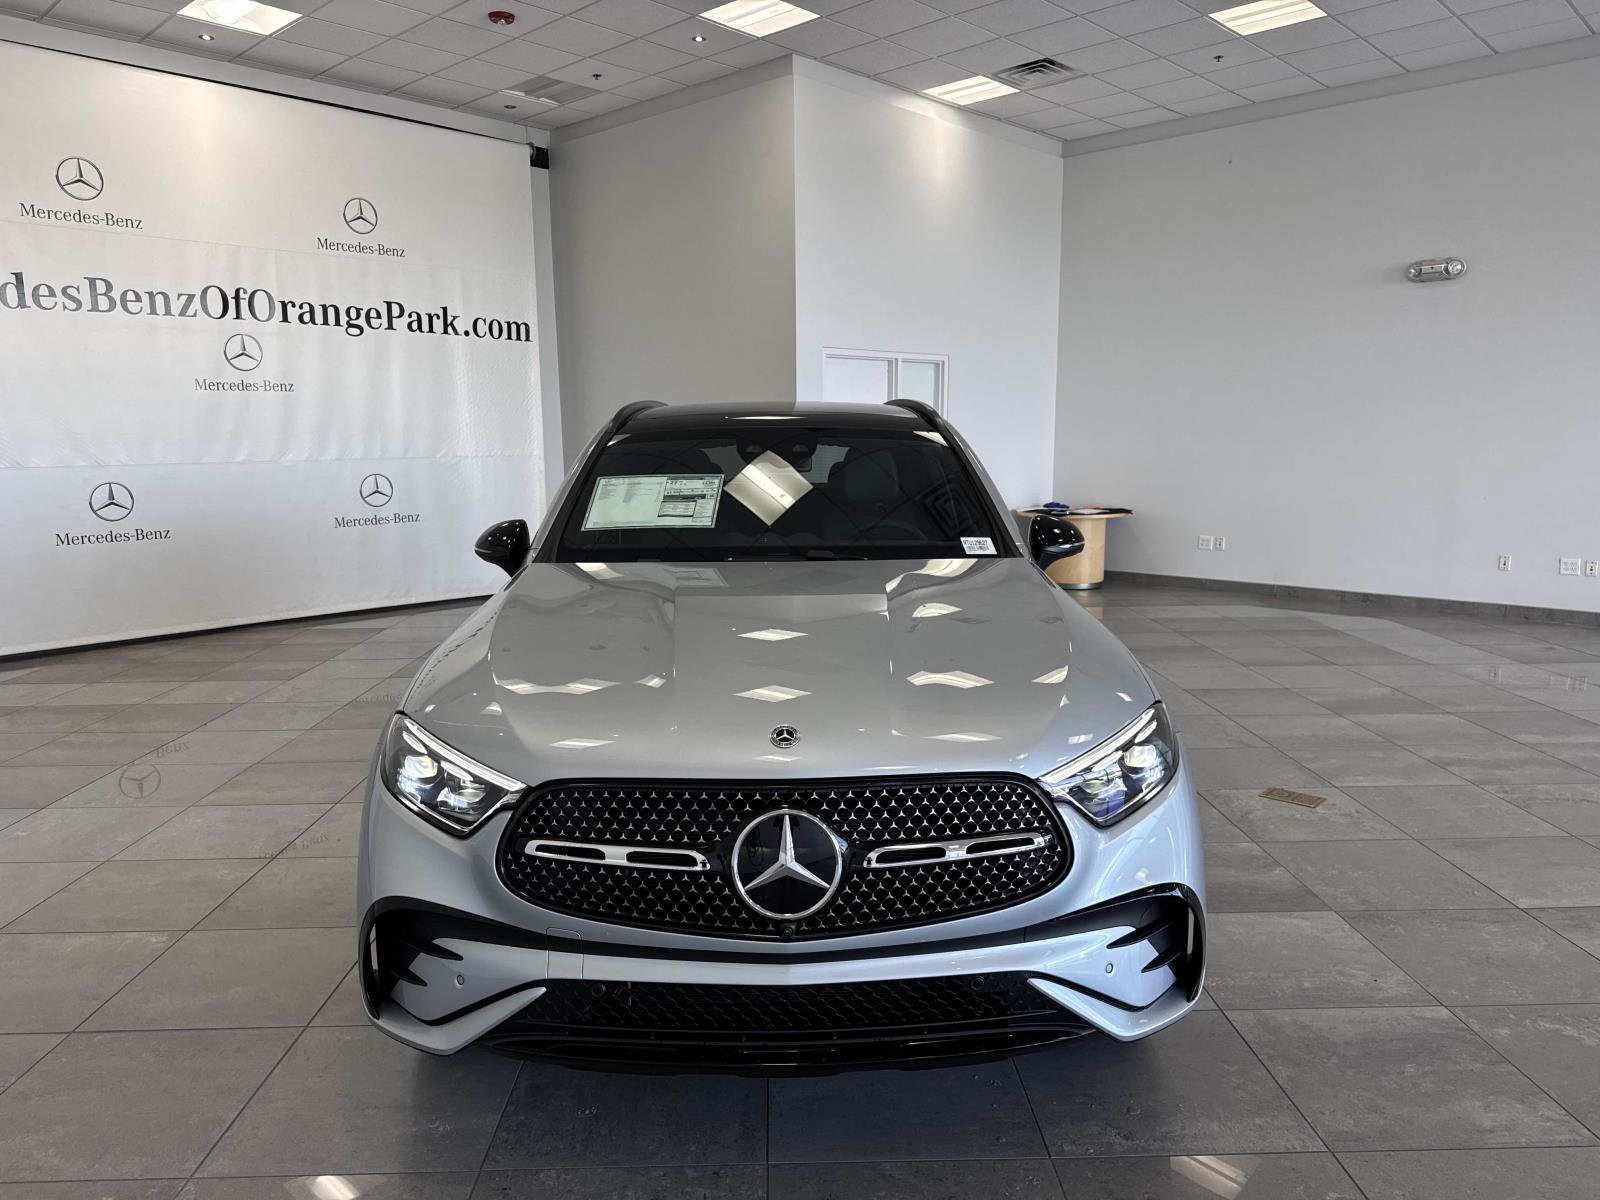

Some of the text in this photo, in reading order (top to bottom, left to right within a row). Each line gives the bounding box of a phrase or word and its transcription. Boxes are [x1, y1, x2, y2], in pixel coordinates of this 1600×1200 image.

[19, 202, 143, 231] Mercedes-Benz
[316, 237, 406, 258] Mercedes-Benz
[0, 271, 534, 343] desBenzOfOrangePark.com
[194, 378, 295, 393] Mercedes-Benz
[334, 512, 421, 529] Mercedes-Benz
[55, 528, 171, 547] Mercedes-Benz
